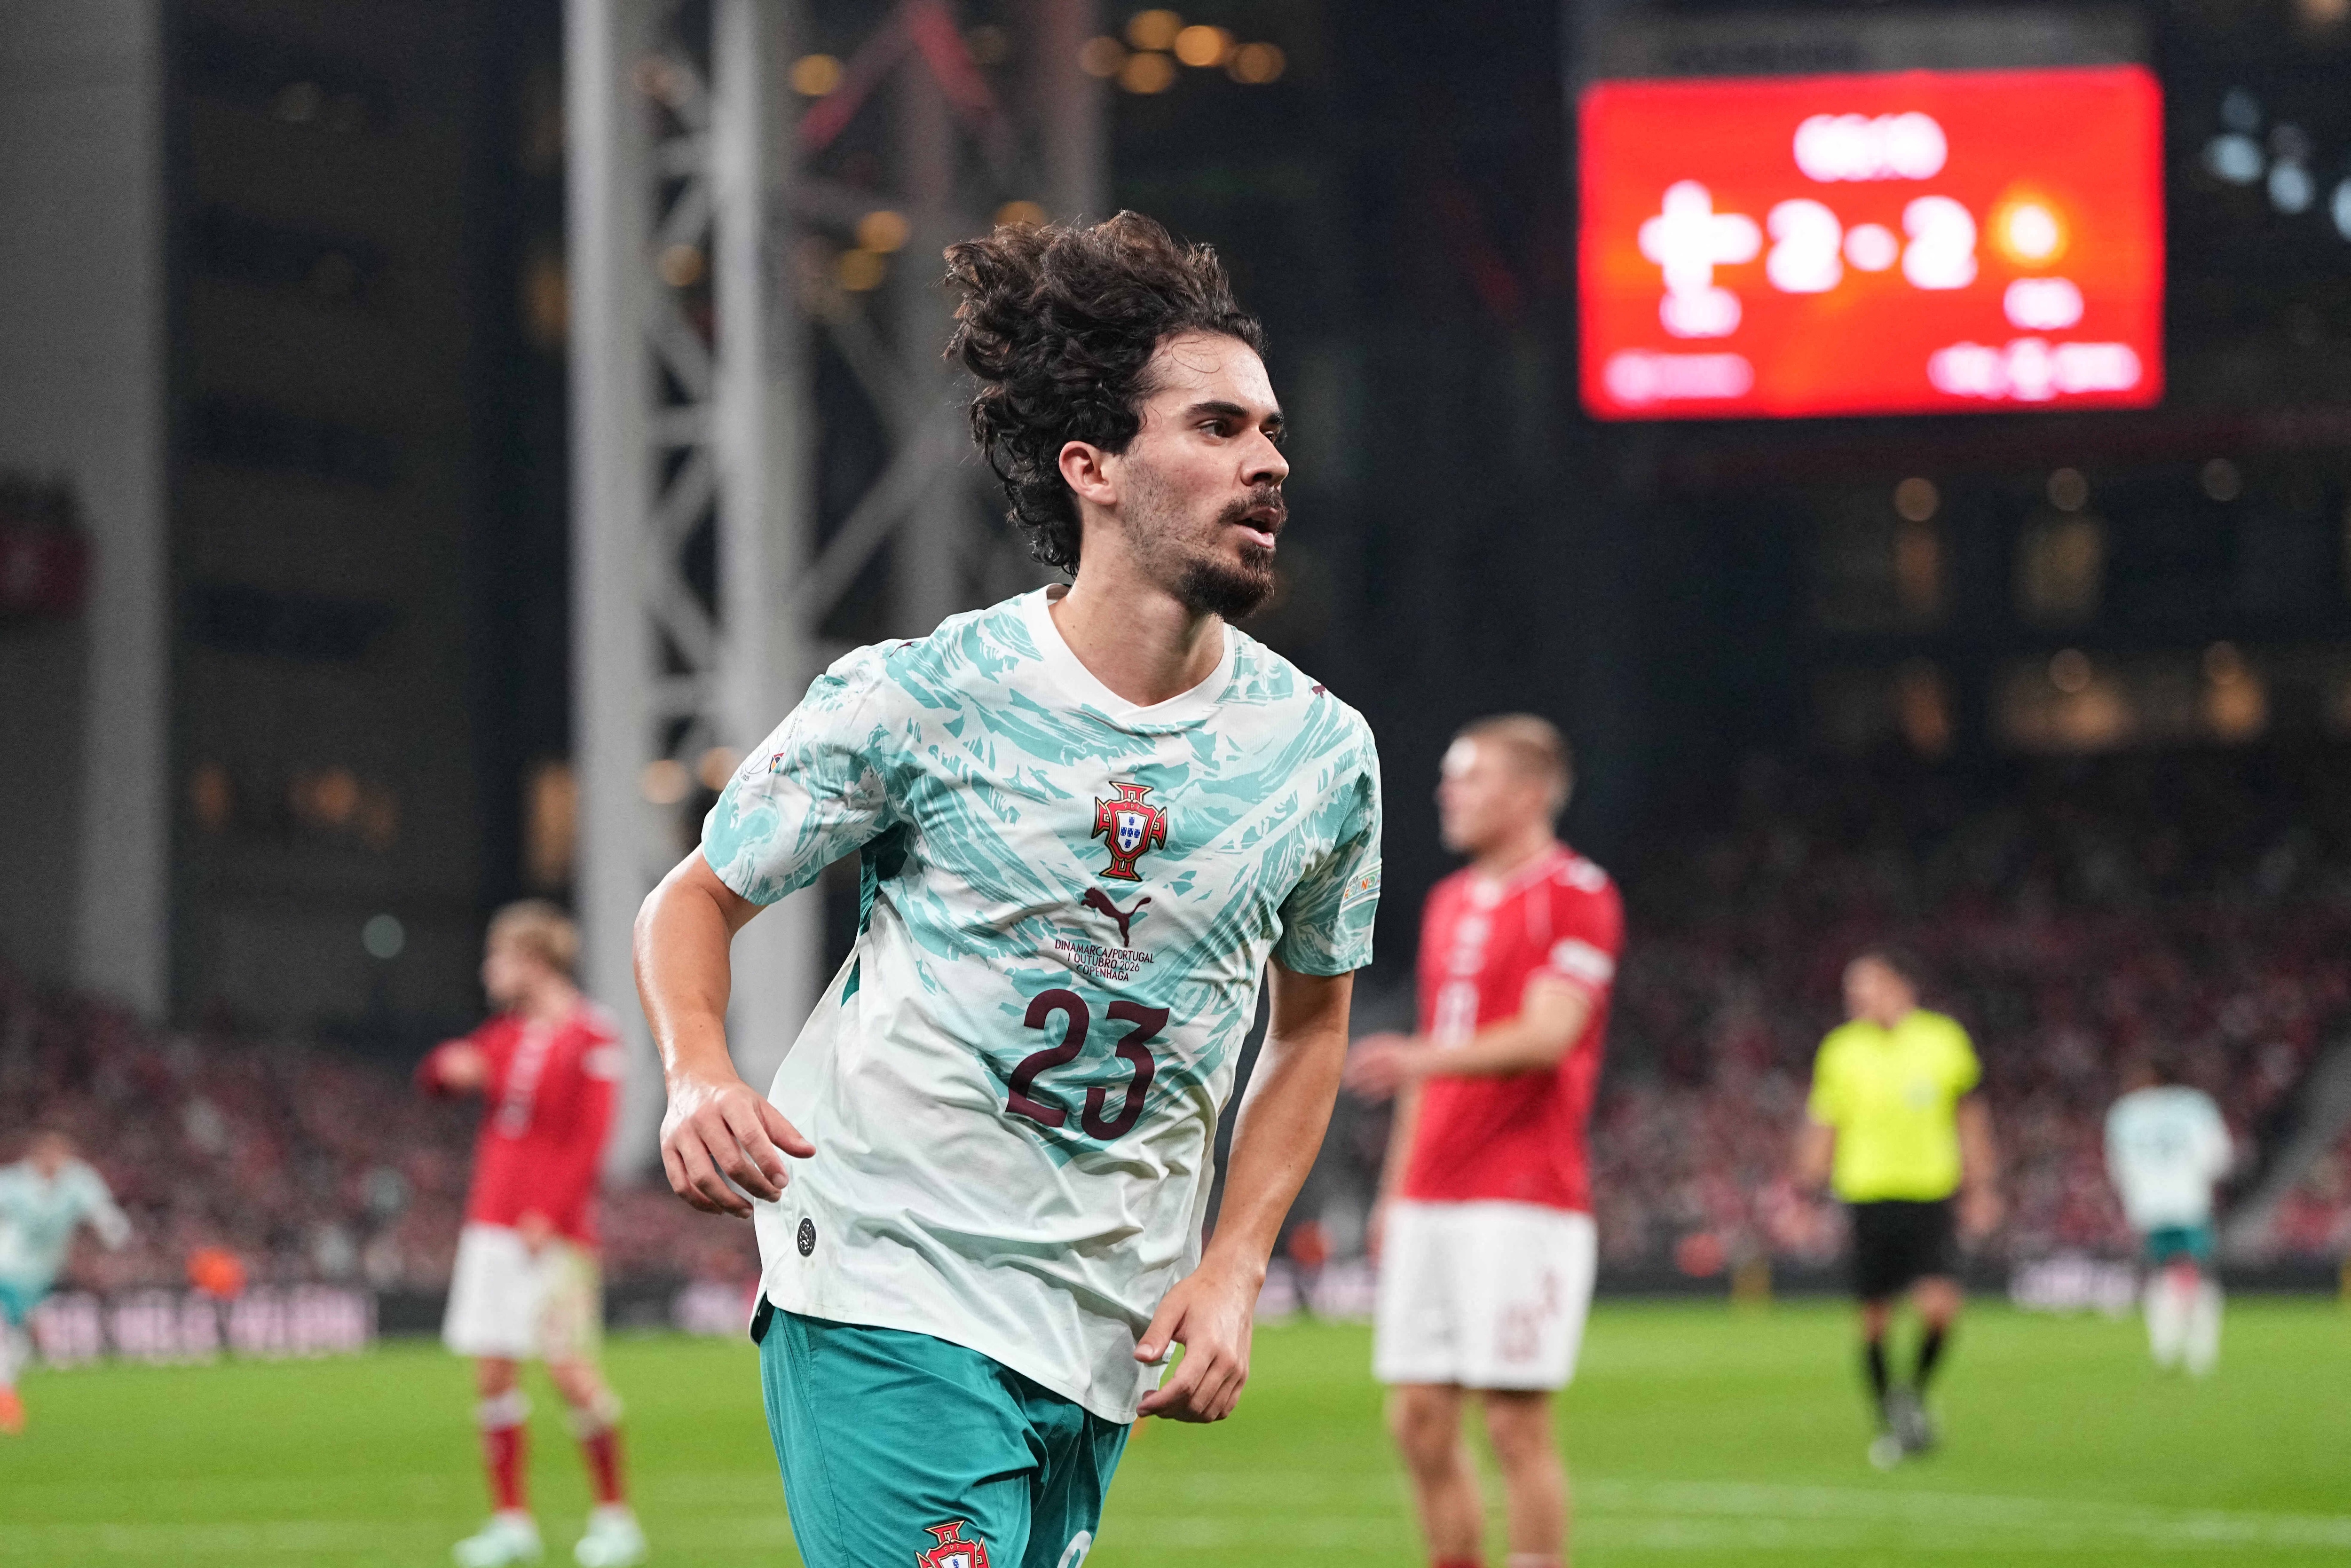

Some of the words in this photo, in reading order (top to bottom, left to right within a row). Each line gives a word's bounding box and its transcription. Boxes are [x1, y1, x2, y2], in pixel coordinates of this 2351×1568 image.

[1055, 939, 1154, 963] DINAMARCA/PORTUGAL
[1074, 953, 1118, 969] OUTUBRO
[1120, 961, 1140, 972] 2026
[1076, 964, 1129, 982] COPENHAGA
[1005, 988, 1170, 1141] 23
